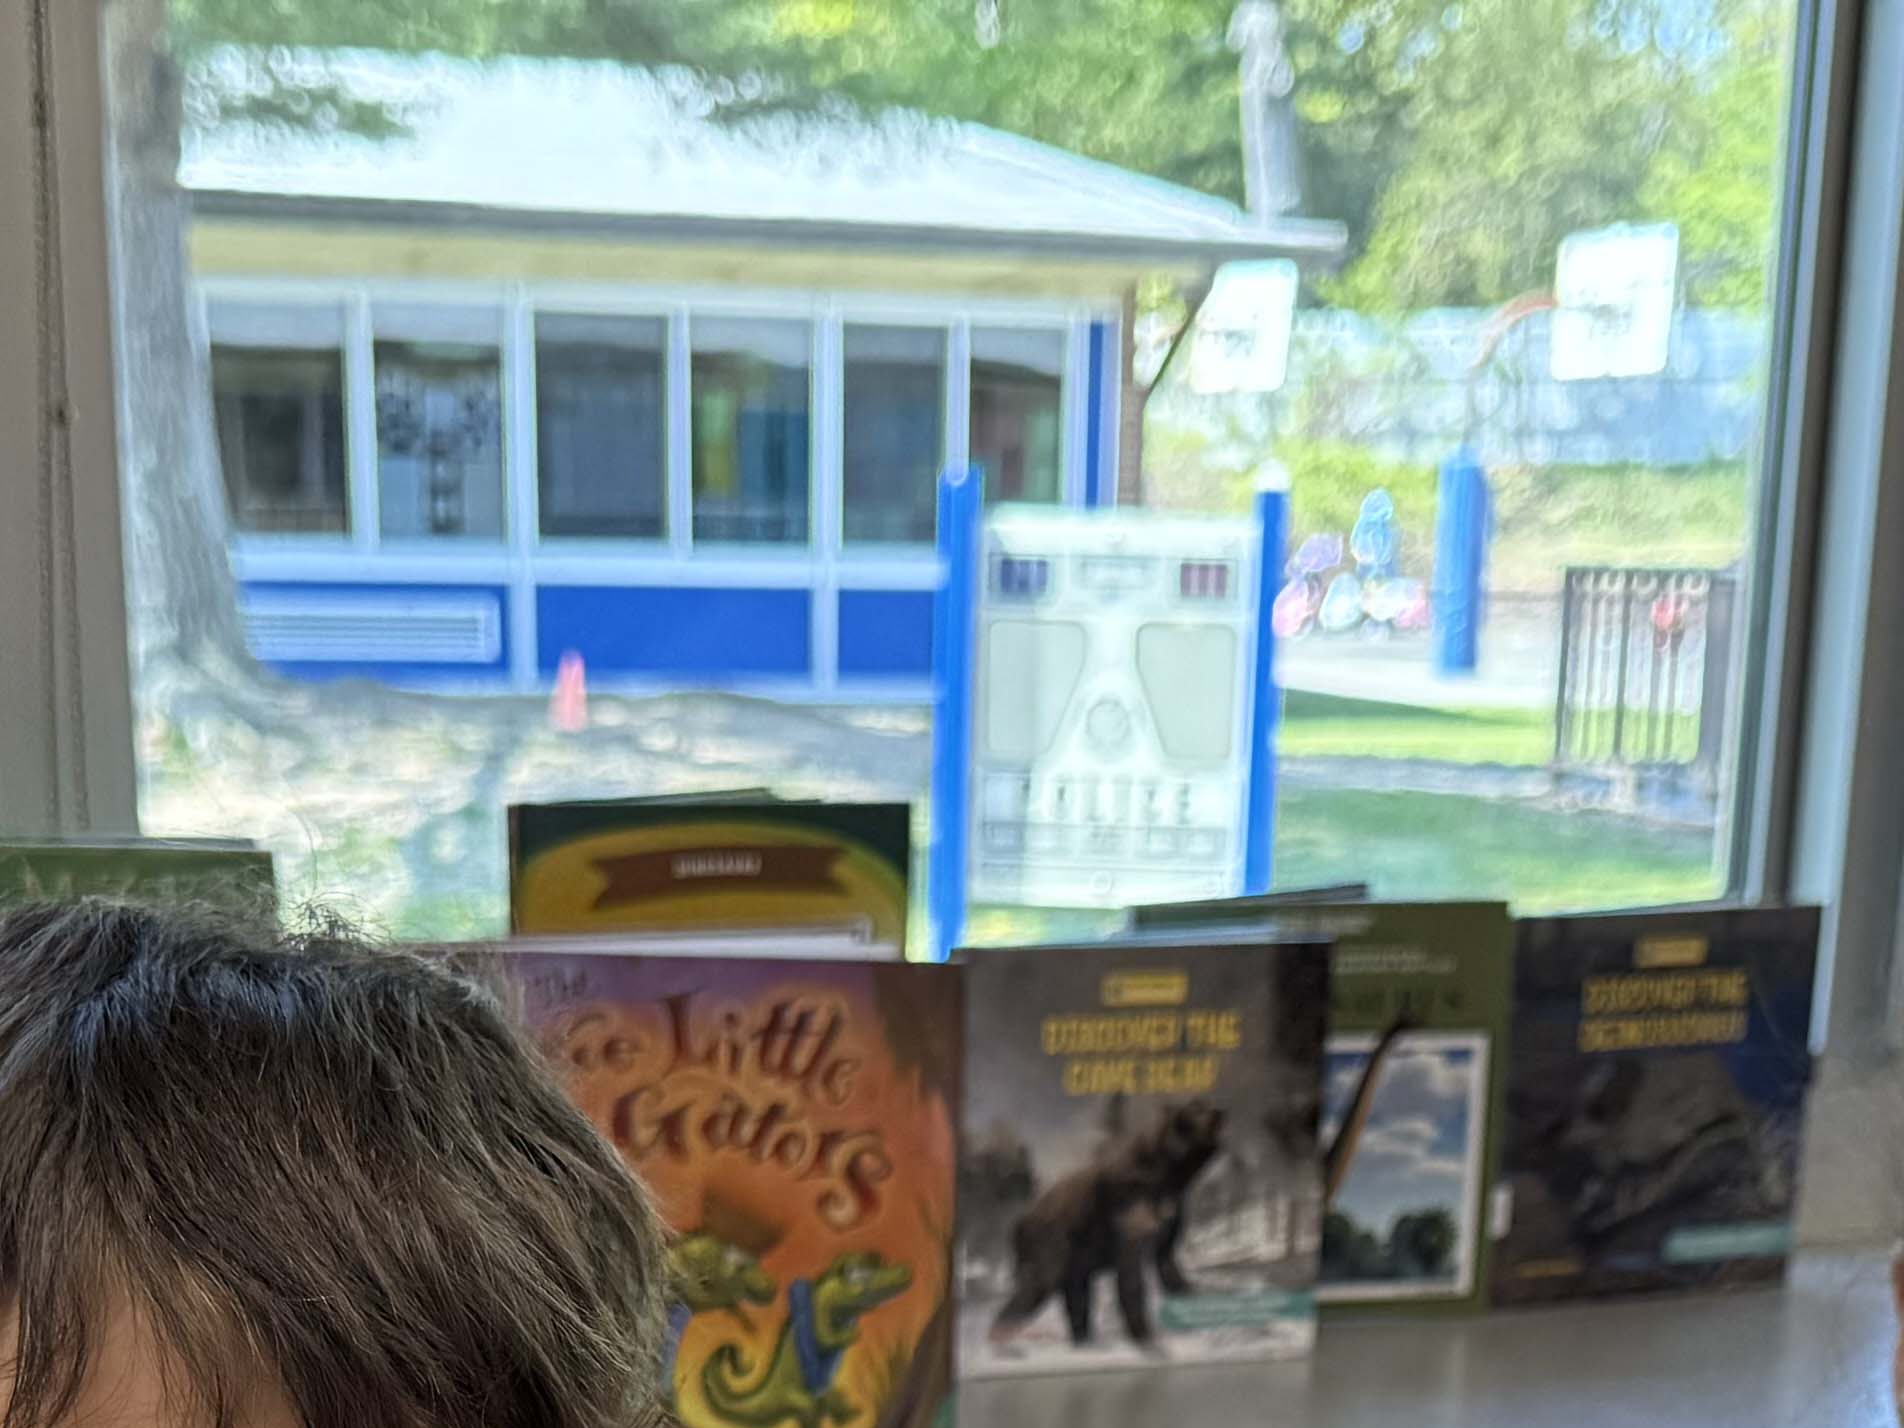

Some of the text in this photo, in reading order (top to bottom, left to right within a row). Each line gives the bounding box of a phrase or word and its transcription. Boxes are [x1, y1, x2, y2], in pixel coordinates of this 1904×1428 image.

[663, 990, 864, 1106] Little
[1041, 1006, 1242, 1056] DISCOVER THE
[610, 1084, 894, 1230] Gators
